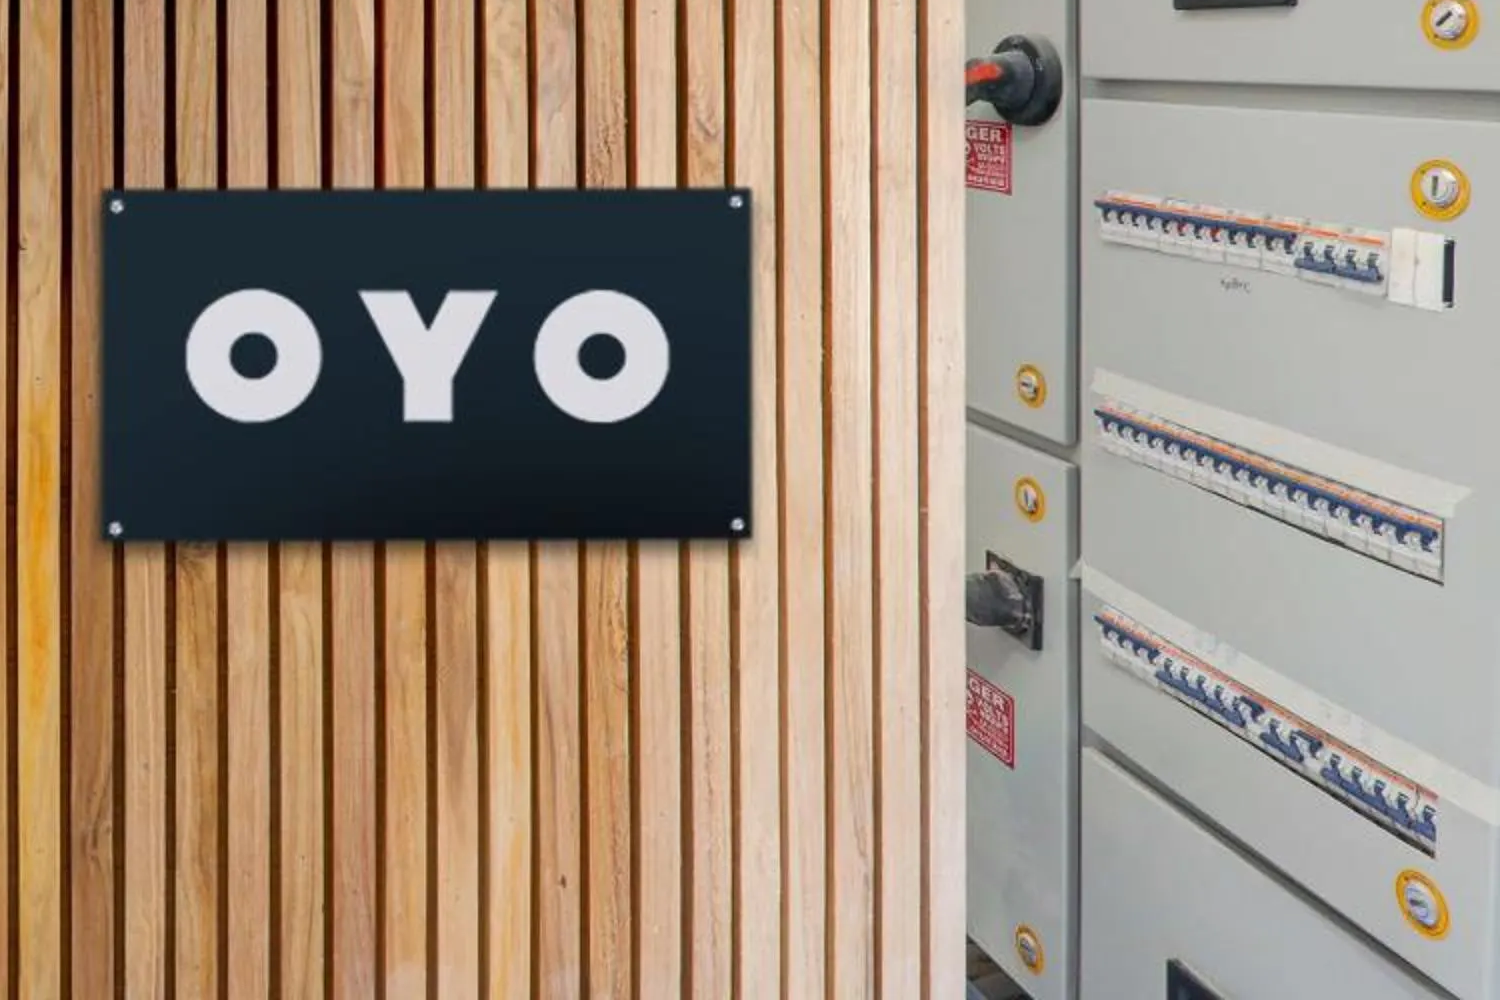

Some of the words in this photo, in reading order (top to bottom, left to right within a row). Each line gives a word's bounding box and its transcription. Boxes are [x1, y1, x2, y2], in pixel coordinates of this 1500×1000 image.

[966, 126, 1002, 142] GER
[185, 288, 671, 424] OYO
[969, 676, 1006, 711] GER
